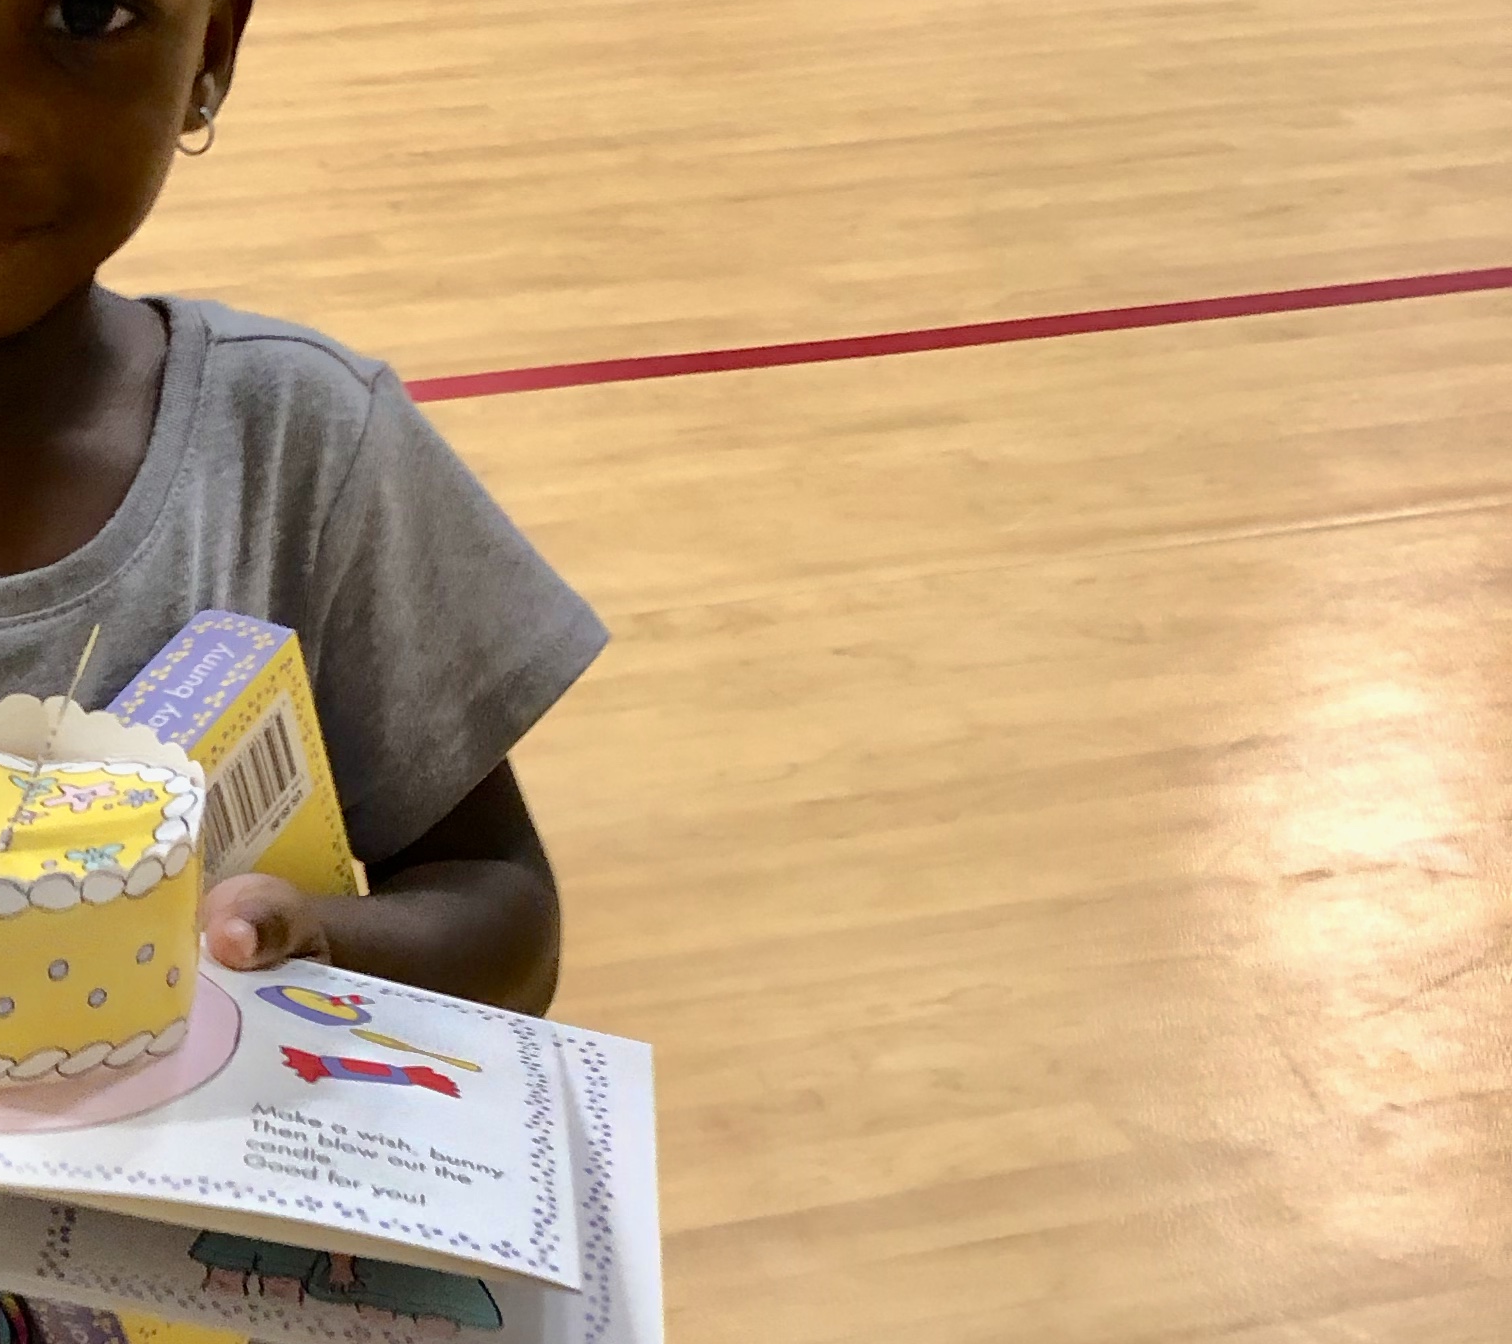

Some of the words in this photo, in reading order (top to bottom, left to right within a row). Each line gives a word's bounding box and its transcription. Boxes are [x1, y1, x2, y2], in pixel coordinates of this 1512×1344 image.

[164, 642, 235, 699] bunny
[148, 702, 182, 733] ay
[251, 1102, 322, 1128] Make
[330, 1122, 348, 1136] a
[252, 1118, 307, 1143] Then
[317, 1132, 379, 1160] blow
[387, 1155, 427, 1173] out
[433, 1166, 473, 1186] the
[243, 1153, 317, 1181] Good
[328, 1169, 360, 1188] for
[371, 1183, 426, 1208] you!
